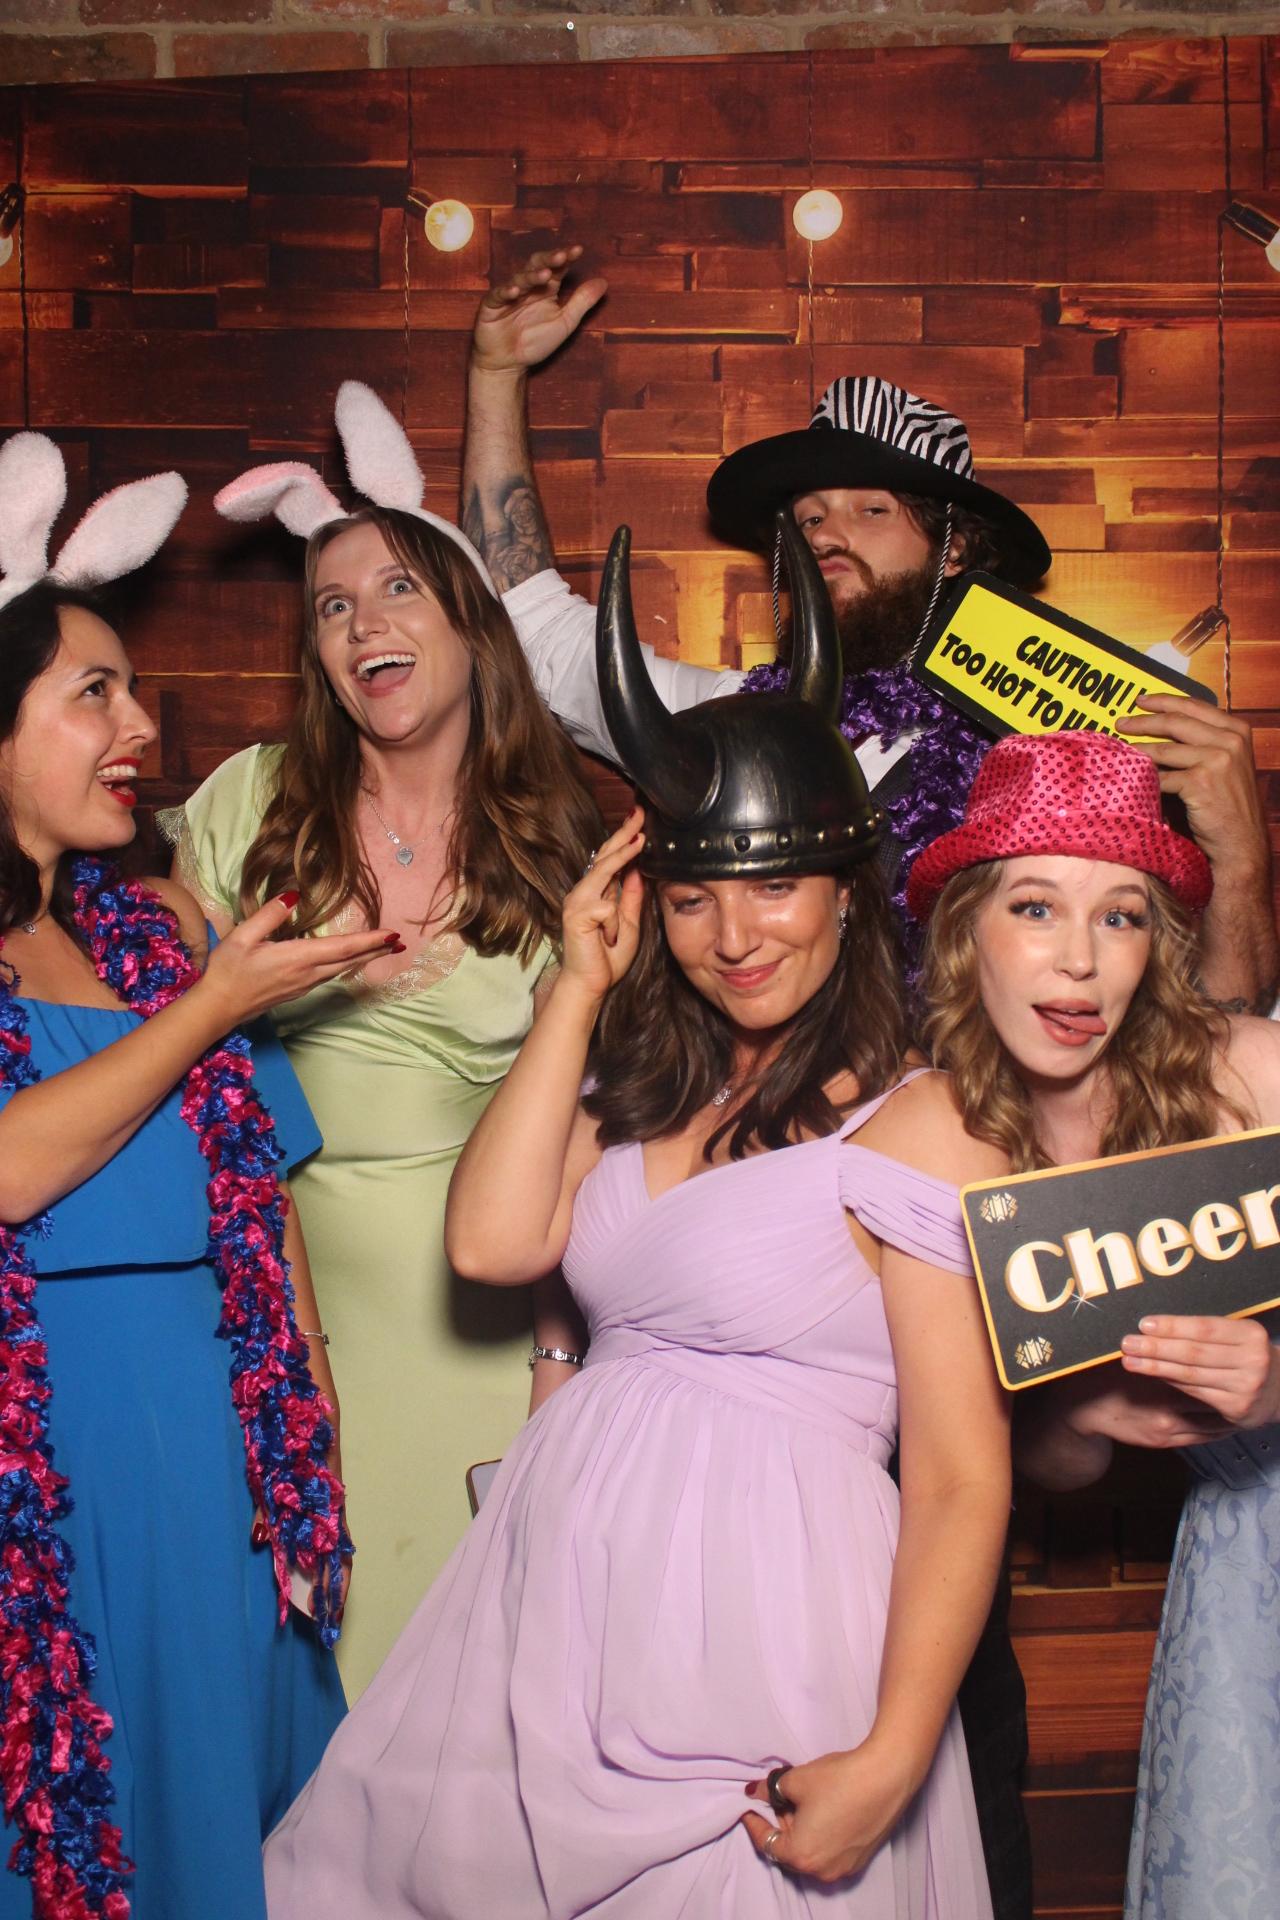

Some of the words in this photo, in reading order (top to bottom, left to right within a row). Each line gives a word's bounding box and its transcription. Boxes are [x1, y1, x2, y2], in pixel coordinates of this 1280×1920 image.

[939, 633, 987, 676] TOO
[980, 661, 1036, 707] HOT
[1027, 688, 1064, 728] TO
